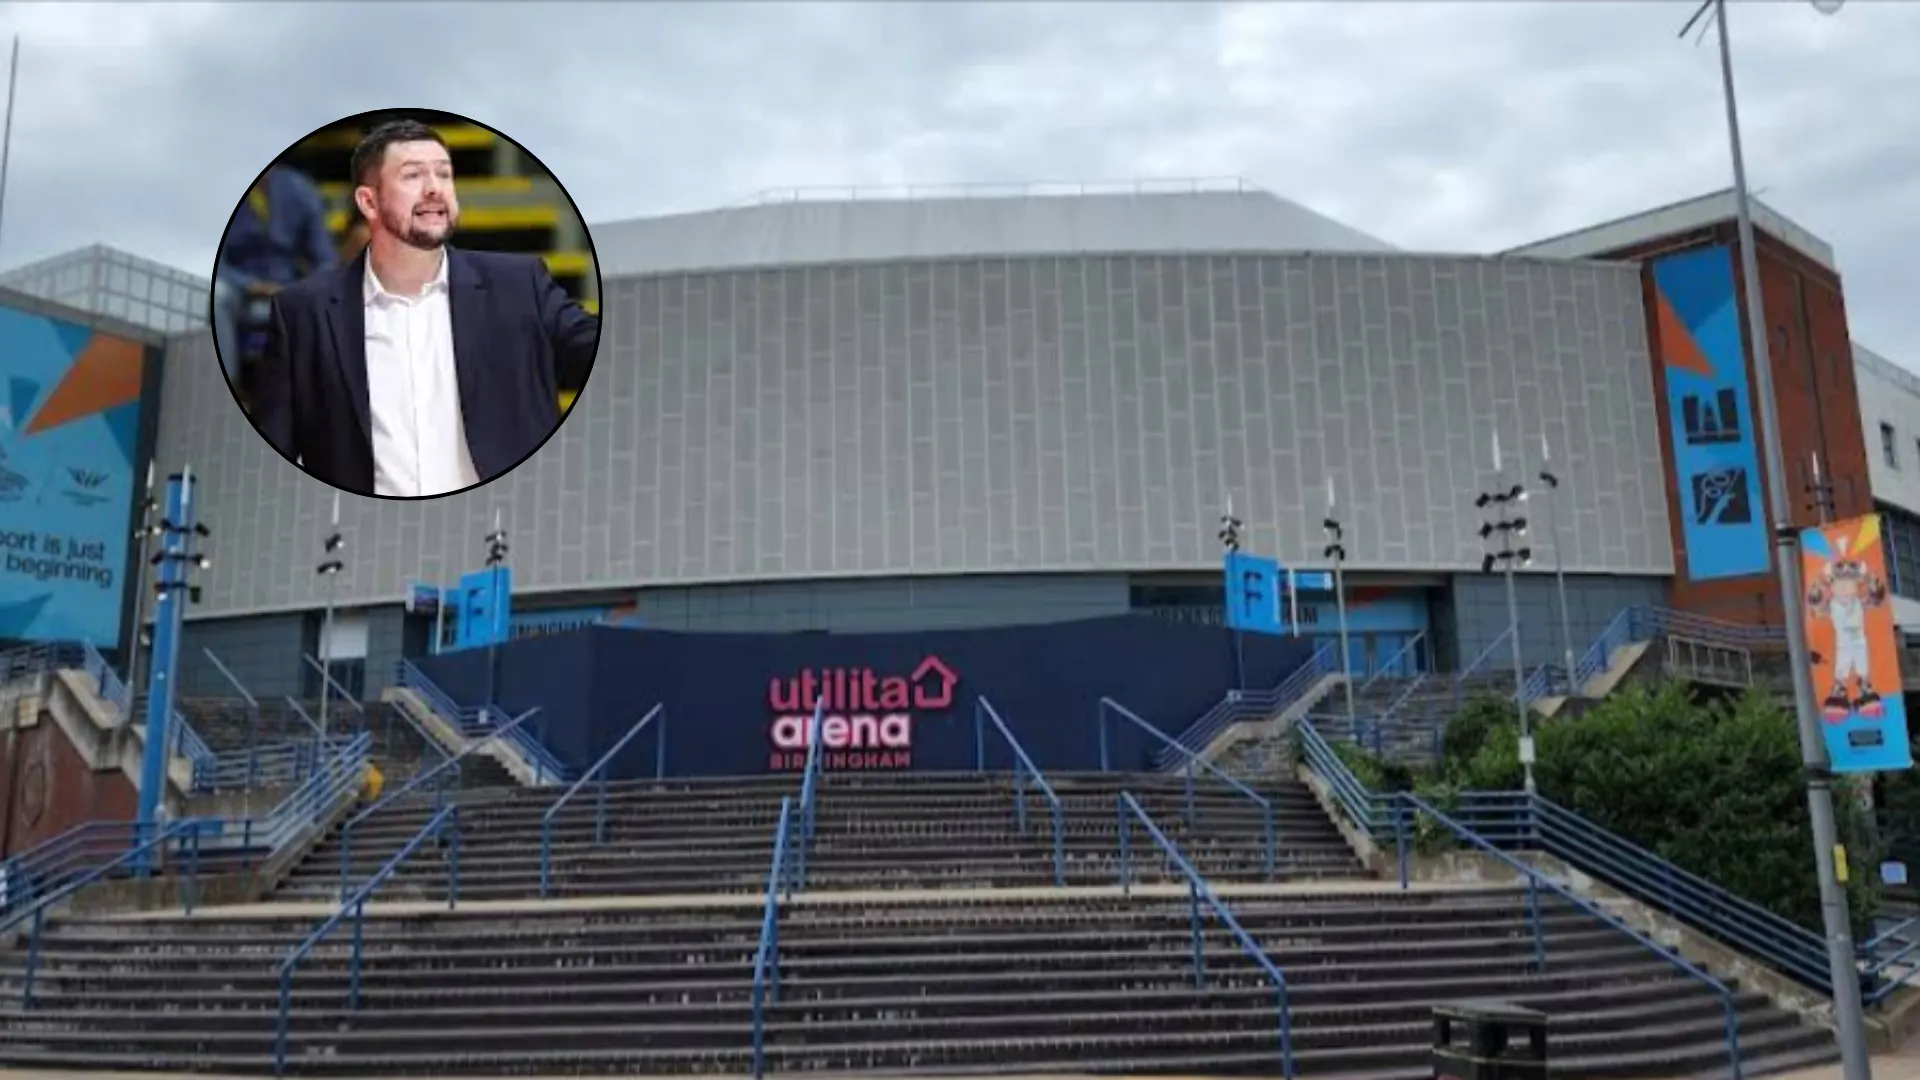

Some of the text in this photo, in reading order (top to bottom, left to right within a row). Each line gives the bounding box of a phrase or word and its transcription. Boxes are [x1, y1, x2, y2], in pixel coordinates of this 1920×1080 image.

[43, 534, 61, 554] is
[67, 536, 105, 562] just
[6, 552, 113, 588] beginning
[768, 667, 909, 711] utilita
[772, 714, 910, 747] arena
[769, 752, 911, 770] BIRINGHAM
